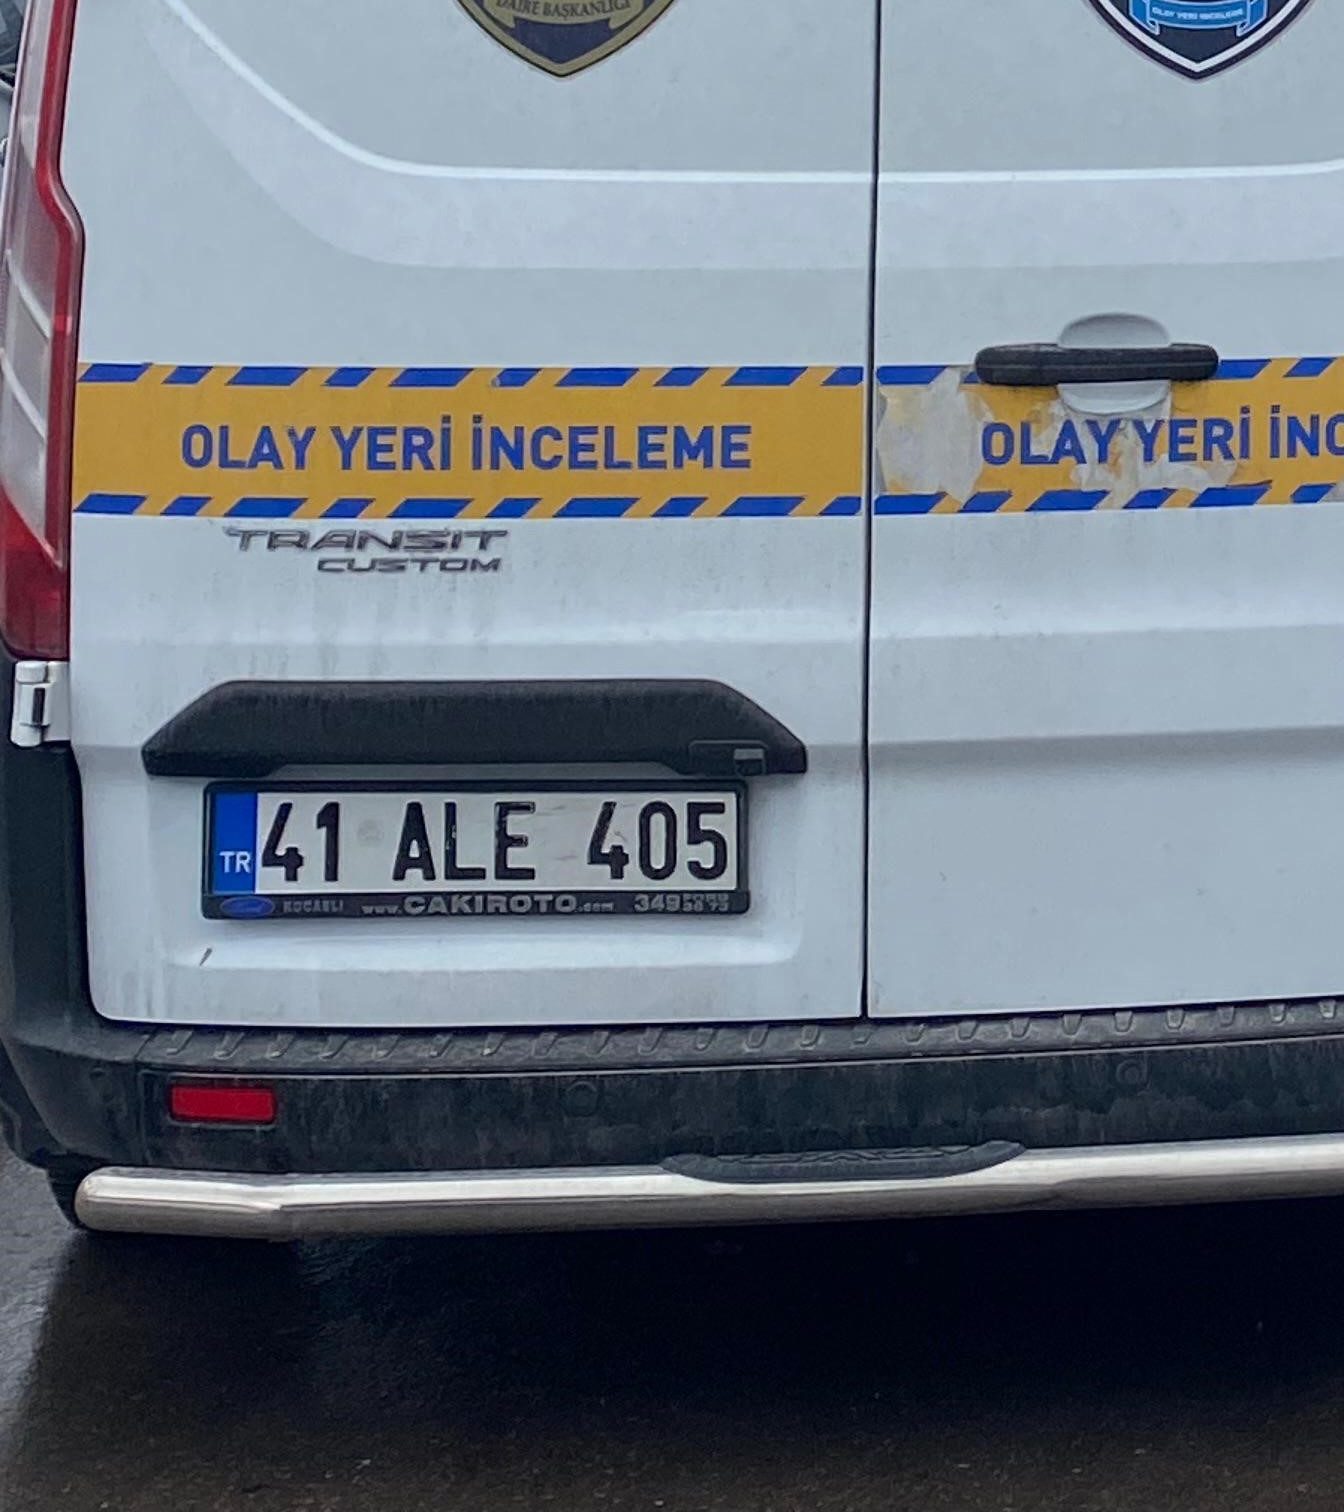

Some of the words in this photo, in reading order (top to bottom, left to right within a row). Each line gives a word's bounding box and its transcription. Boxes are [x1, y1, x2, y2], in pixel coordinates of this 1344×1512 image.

[180, 424, 316, 472] OLAY
[329, 414, 452, 471] YERİ
[472, 414, 753, 470] İNCELEME
[980, 418, 1121, 465] OLAY
[1132, 405, 1250, 464] YERİ
[223, 526, 508, 552] TRANSIT
[317, 557, 502, 573] CUSTOM
[219, 851, 251, 874] TR
[261, 801, 341, 883] 41
[392, 801, 536, 882] ALE
[586, 800, 729, 882] 405
